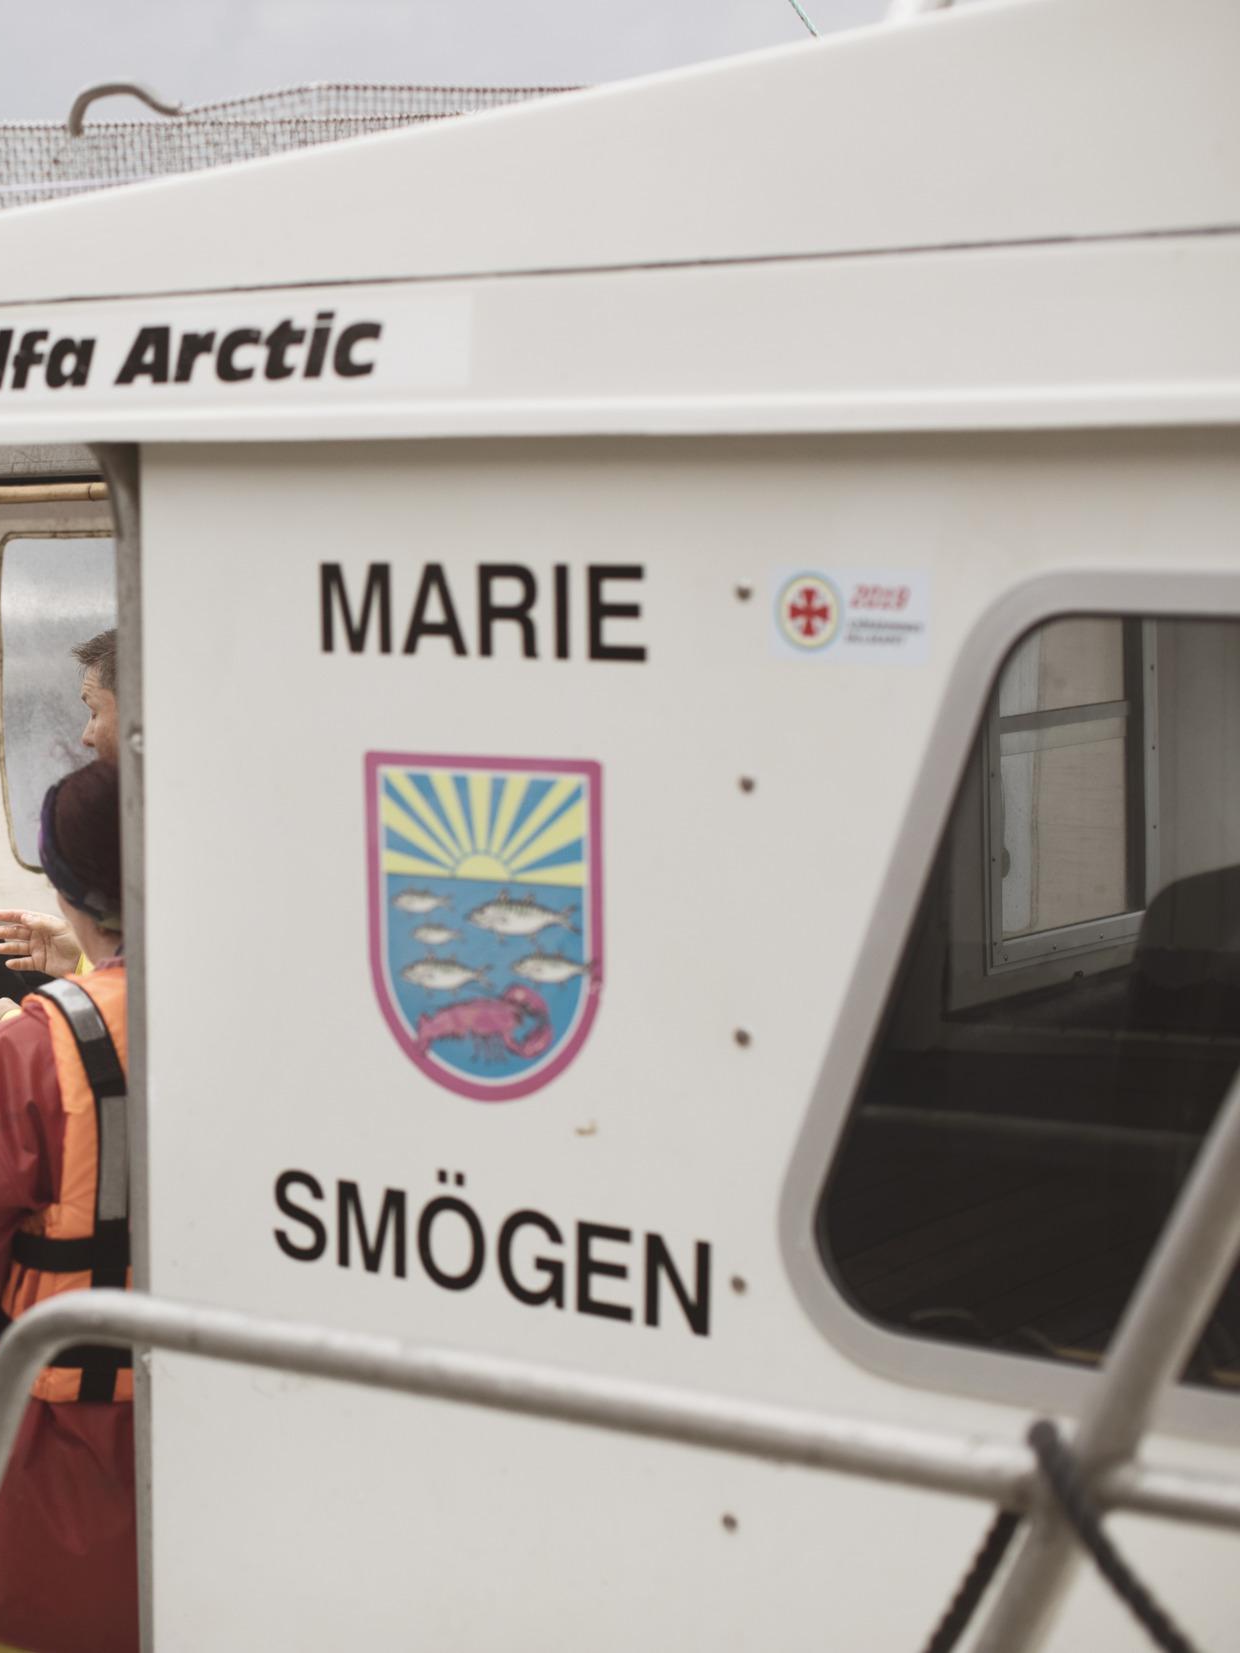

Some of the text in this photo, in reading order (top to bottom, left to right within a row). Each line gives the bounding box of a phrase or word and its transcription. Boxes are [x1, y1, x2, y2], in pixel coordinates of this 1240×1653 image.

[115, 312, 382, 385] Arctic
[320, 563, 647, 663] MARIE
[274, 1170, 711, 1337] SMÖGEN
